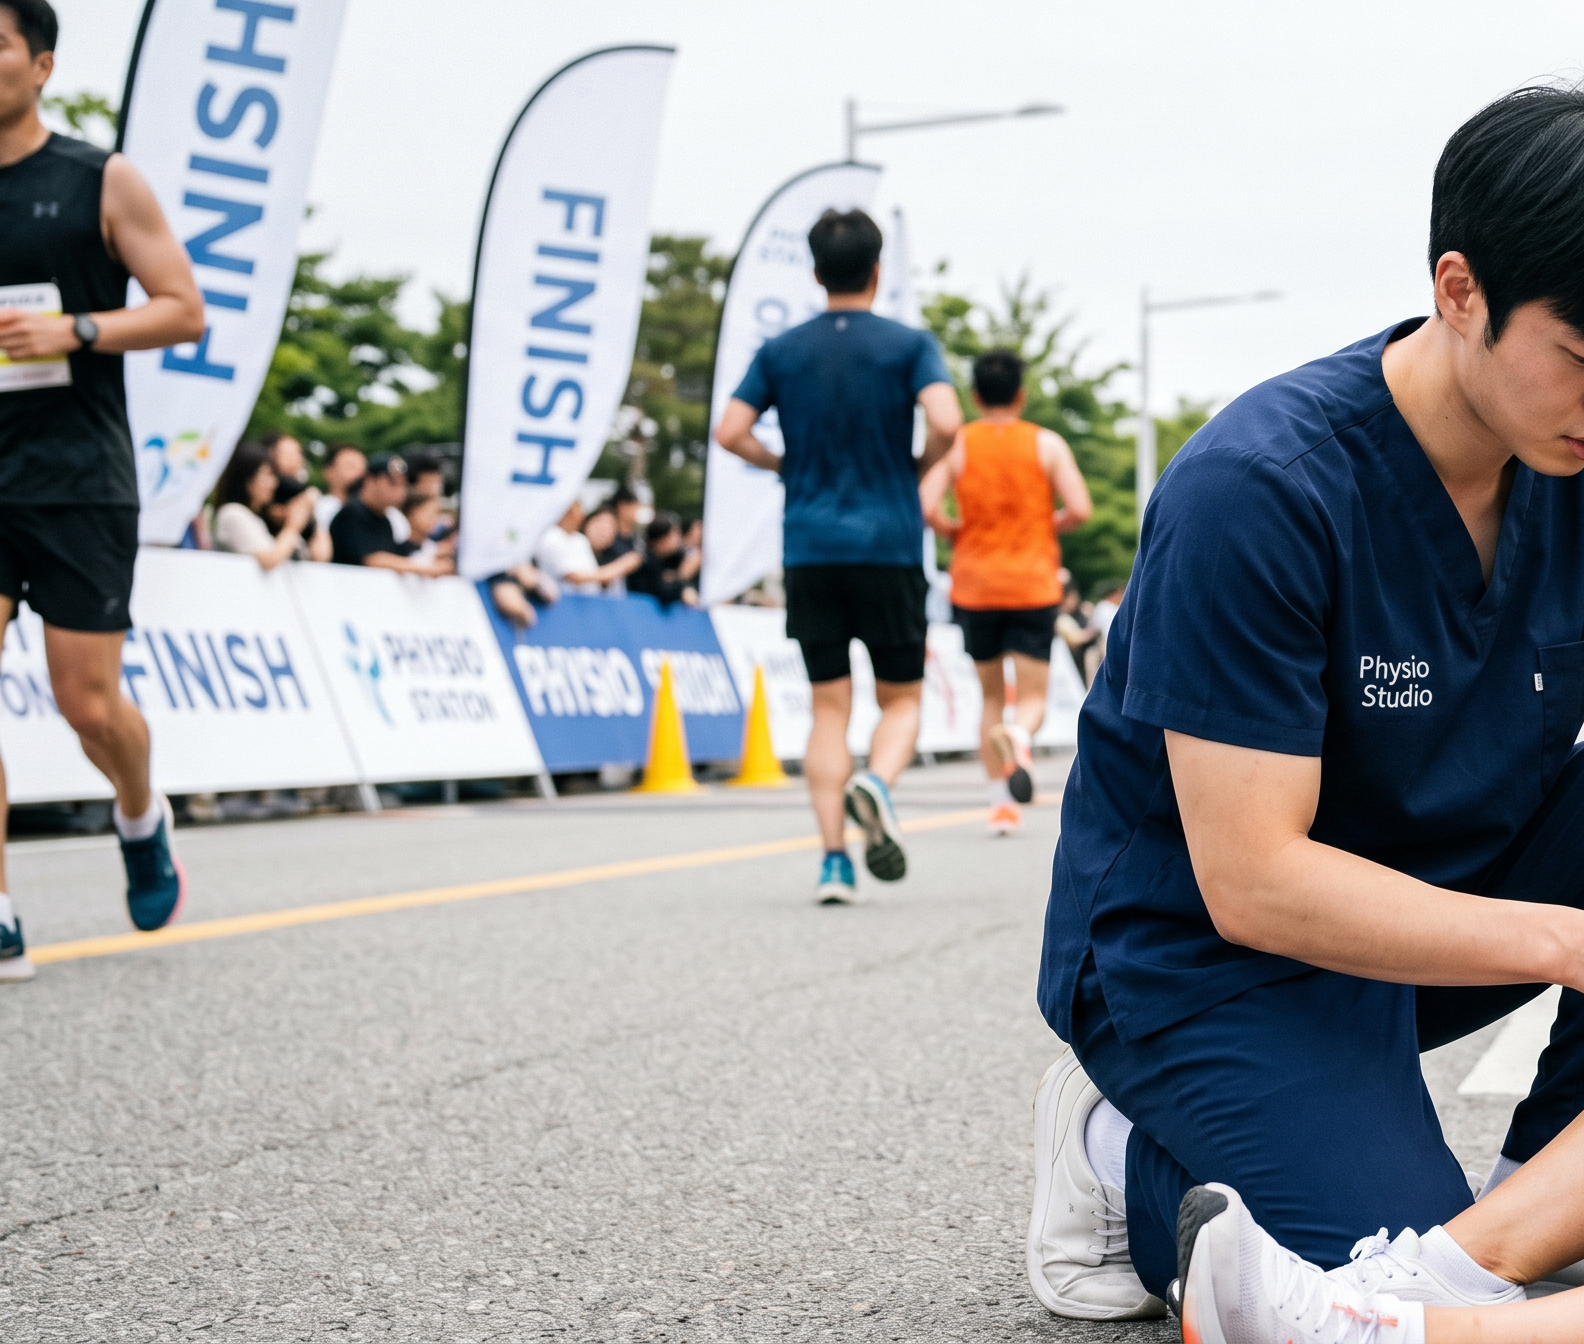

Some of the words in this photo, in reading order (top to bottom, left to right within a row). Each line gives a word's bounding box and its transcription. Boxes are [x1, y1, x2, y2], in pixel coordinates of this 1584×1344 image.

[161, 0, 296, 382] FINISH
[510, 188, 606, 487] FINISH
[122, 627, 310, 710] FINISH
[1359, 655, 1430, 686] Physio
[1361, 683, 1433, 708] Studio
